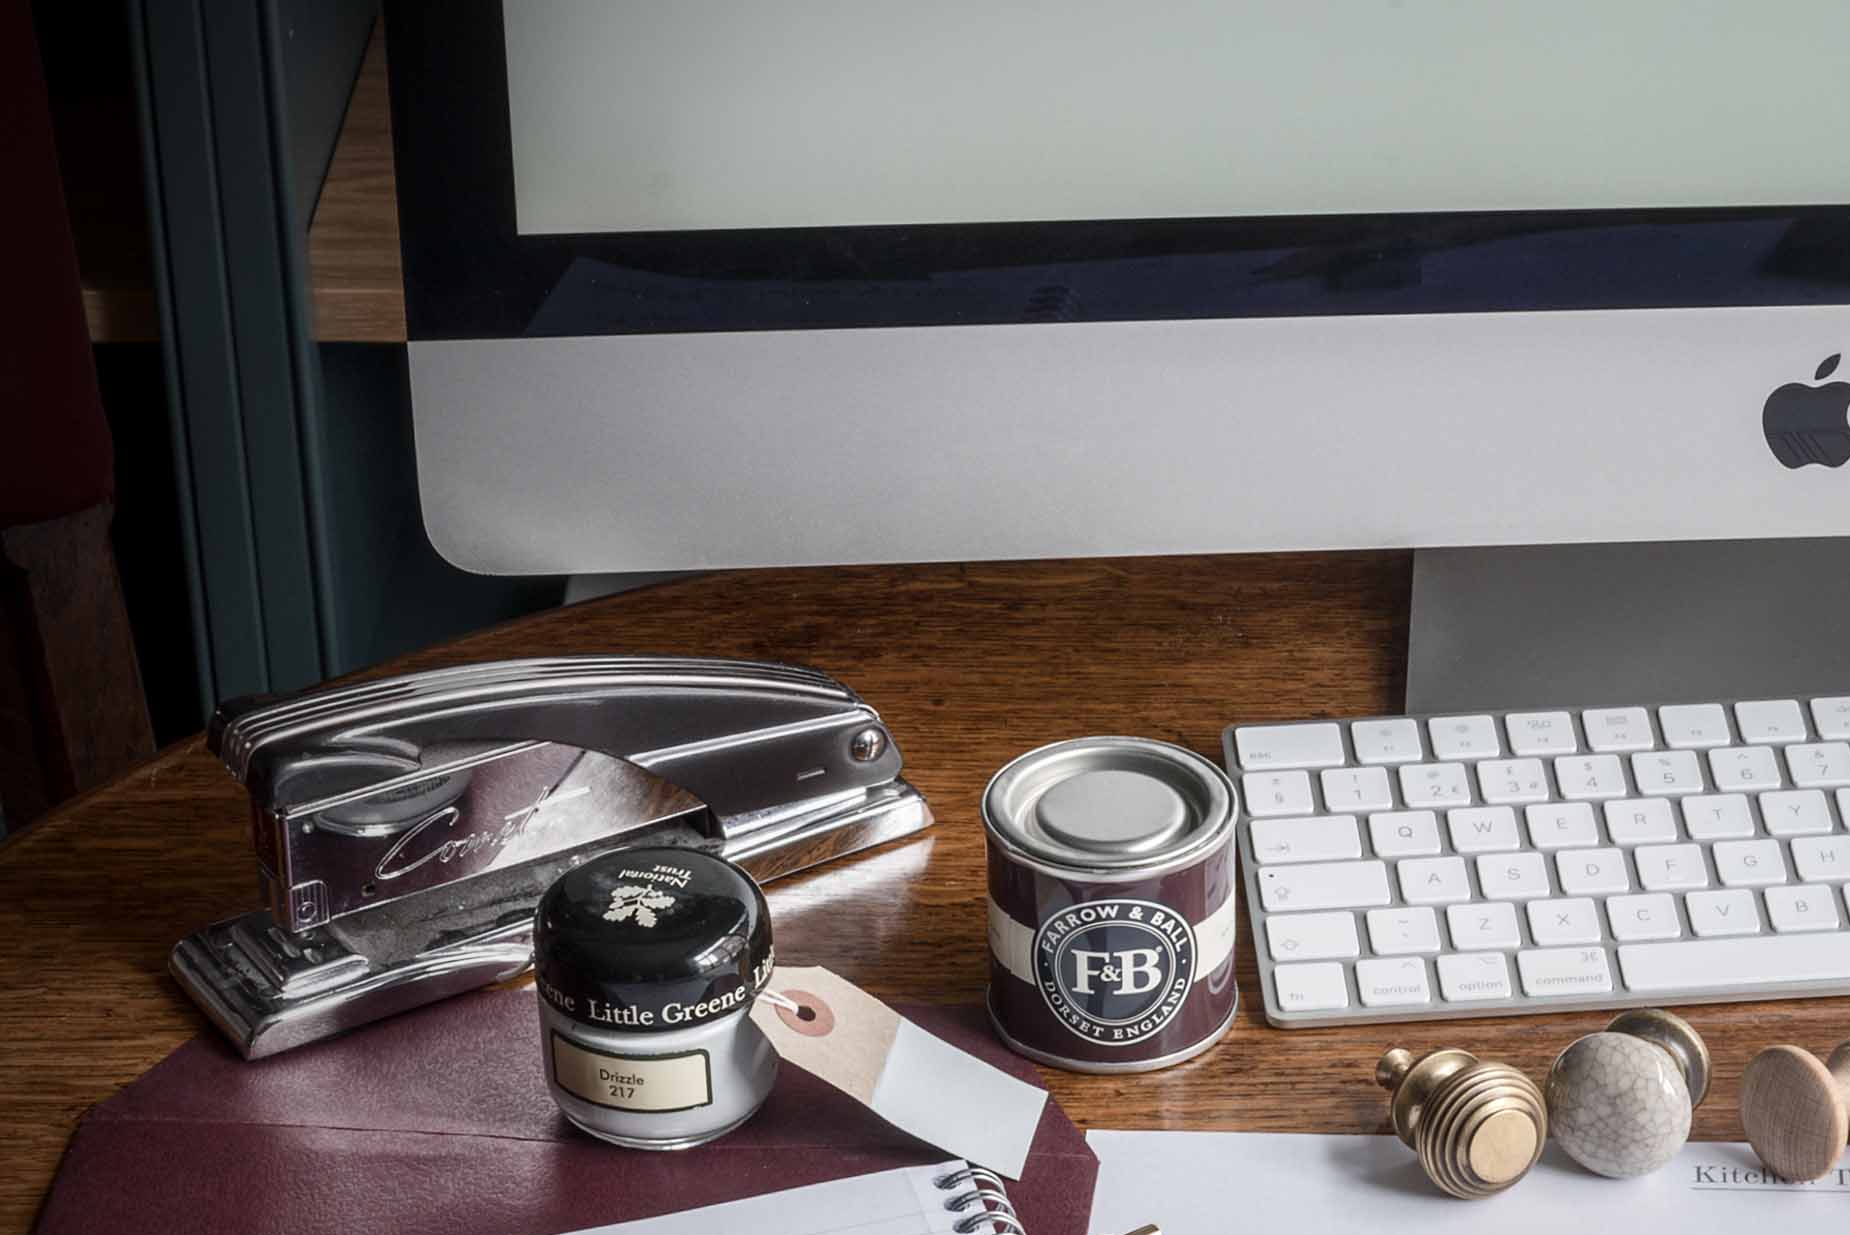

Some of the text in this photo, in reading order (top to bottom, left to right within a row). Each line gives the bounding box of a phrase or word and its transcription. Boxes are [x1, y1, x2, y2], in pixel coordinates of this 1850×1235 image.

[1789, 804, 1800, 817] Y
[1633, 813, 1647, 825] R
[1397, 826, 1413, 839] Q
[1473, 820, 1493, 834] W
[1744, 854, 1758, 868] G
[1819, 849, 1835, 863] H
[652, 863, 693, 879] Trust
[1506, 867, 1521, 880] S
[1585, 863, 1600, 877] D
[618, 868, 689, 889] National
[1427, 872, 1441, 884] A
[1715, 904, 1730, 918] V
[1795, 900, 1809, 914] B
[1556, 913, 1569, 926] X
[1636, 908, 1649, 922] C
[1040, 904, 1188, 954] FARROW & BALL
[1478, 917, 1492, 930] Z
[1458, 979, 1504, 992] option
[1535, 973, 1605, 985] command
[587, 984, 747, 1026] Little Greene
[1043, 977, 1187, 1041] DORSET ENGLAND
[599, 1067, 645, 1087] Drizzle
[608, 1084, 636, 1100] 217
[1693, 1165, 1816, 1185] Kitch
